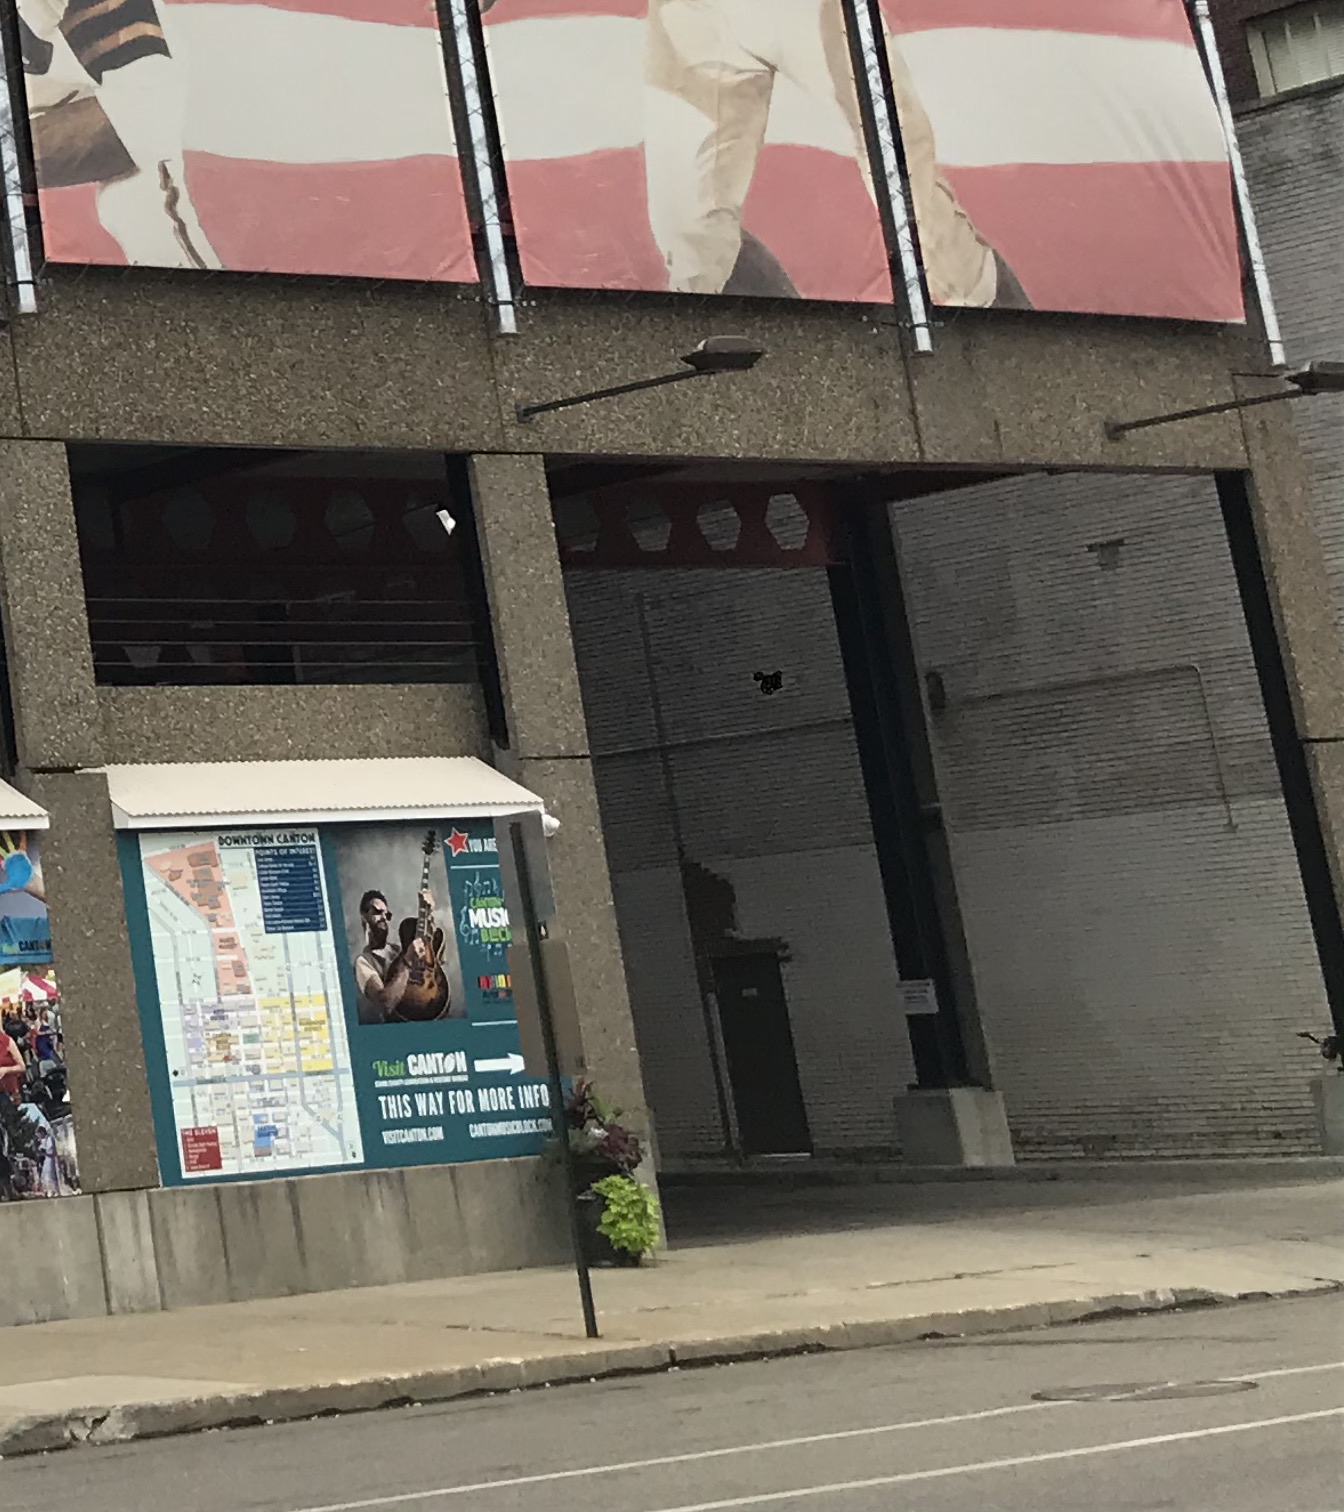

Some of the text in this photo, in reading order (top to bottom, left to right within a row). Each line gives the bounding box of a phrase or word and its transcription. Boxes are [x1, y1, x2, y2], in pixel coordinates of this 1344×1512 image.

[218, 833, 315, 846] DOWNTOWN CANTON
[468, 838, 482, 852] YOU
[372, 1051, 467, 1077] Visit CANTON
[378, 1084, 550, 1119] THIS WAY FOR MORE INFO
[382, 1126, 444, 1144] VISITCANTON.COM
